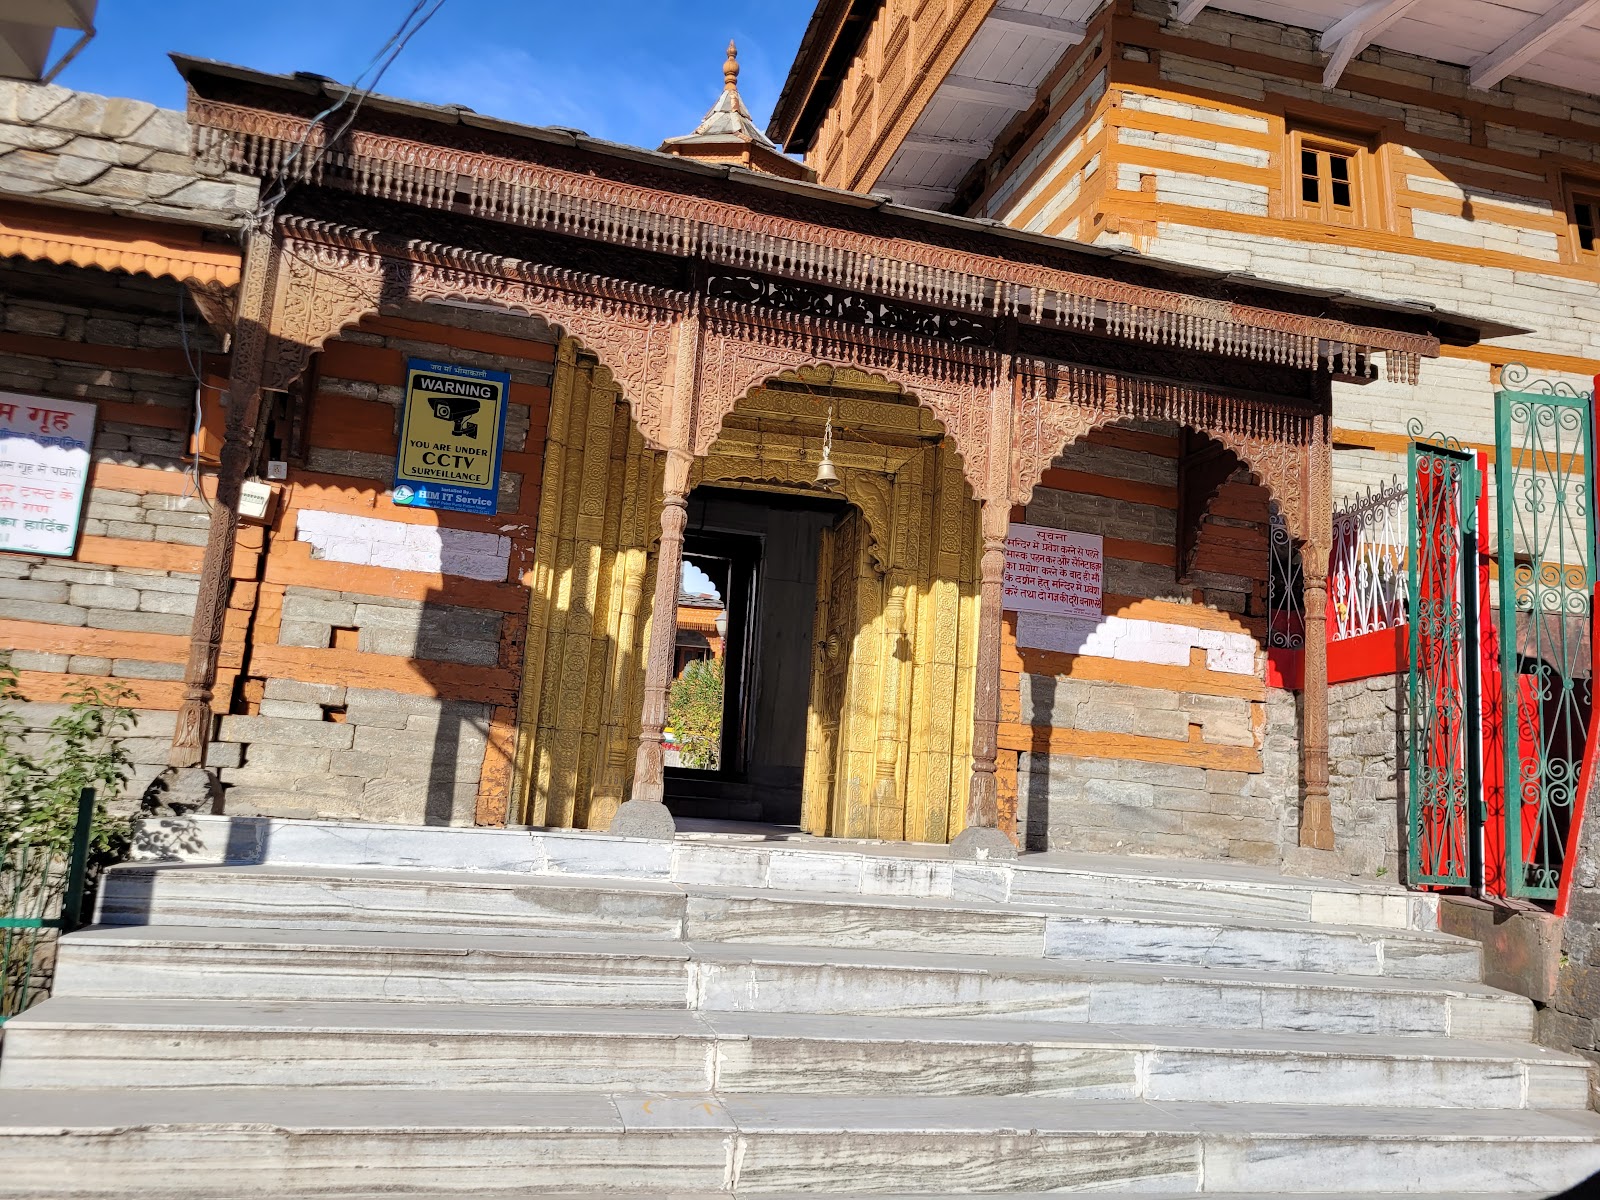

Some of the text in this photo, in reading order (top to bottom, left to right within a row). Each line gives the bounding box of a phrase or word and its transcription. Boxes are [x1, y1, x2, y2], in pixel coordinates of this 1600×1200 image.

[420, 377, 491, 398] WARNING
[26, 406, 76, 434] गृह
[409, 439, 488, 457] YOU ARE UNDER
[422, 451, 475, 469] CCTV
[411, 466, 481, 482] SURVEILLANCE
[418, 489, 440, 500] HIM
[442, 492, 453, 502] IT
[455, 494, 492, 506] Service
[24, 517, 70, 533] हार्दिक
[1036, 530, 1068, 541] सूचना
[1007, 537, 1100, 559] मन्दिर में प्रवेश करने से पहले
[1006, 549, 1028, 560] मास्क
[1057, 555, 1070, 566] और
[1006, 561, 1017, 571] का
[1019, 561, 1039, 574] प्रयोग
[1041, 566, 1058, 577] करने
[1059, 566, 1067, 577] के
[1069, 569, 1082, 579] बाद
[1083, 570, 1091, 582] ही
[1004, 572, 1013, 582] के
[1015, 574, 1036, 586] दर्शन
[1037, 576, 1050, 590] हेतु
[1051, 578, 1075, 592] मन्दिर
[1083, 583, 1100, 595] प्रवेश
[1004, 585, 1019, 597] करें
[1020, 589, 1036, 599] तथा
[1037, 589, 1046, 601] दो
[1069, 594, 1079, 607] दूरी
